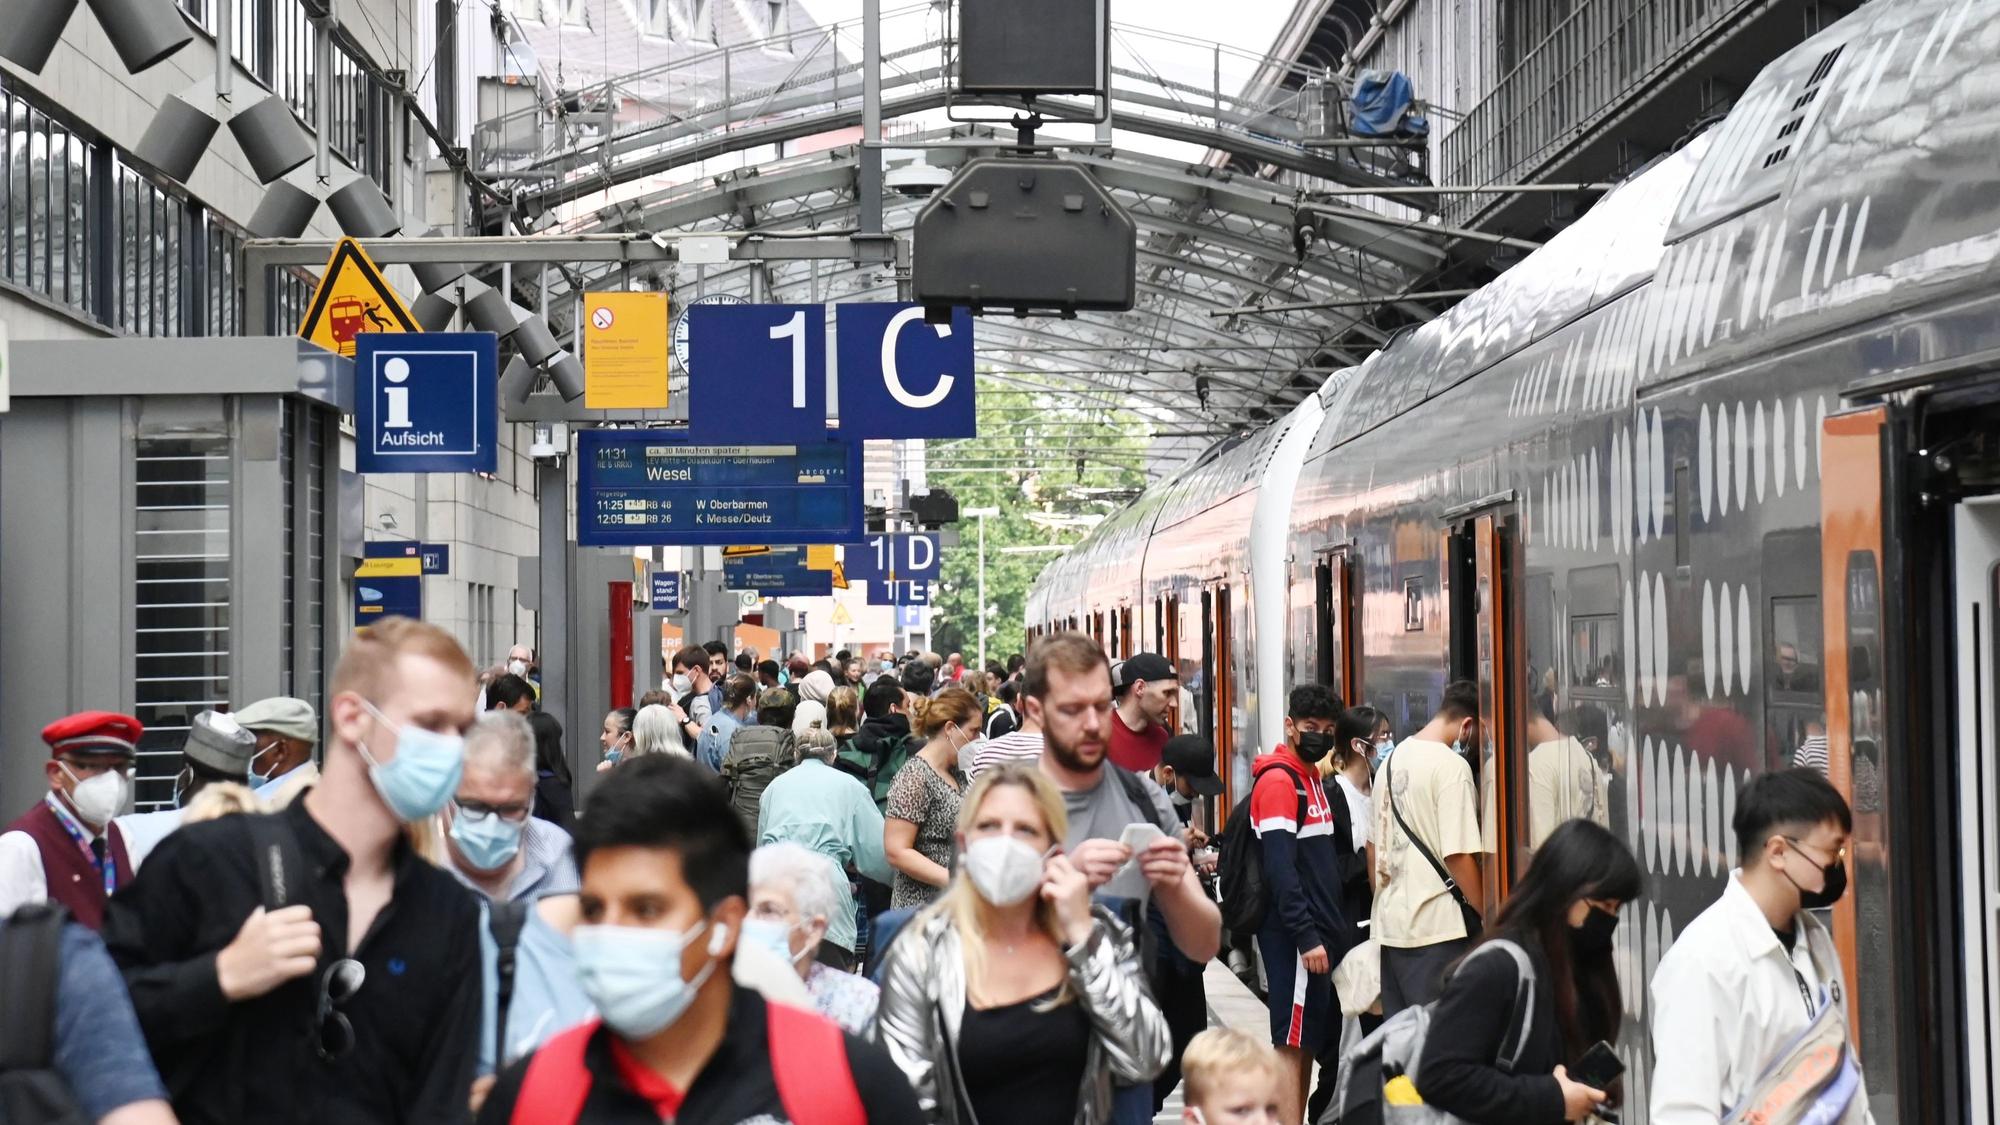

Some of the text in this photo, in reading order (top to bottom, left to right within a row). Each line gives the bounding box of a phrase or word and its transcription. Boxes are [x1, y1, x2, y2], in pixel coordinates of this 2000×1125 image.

[769, 306, 954, 408] 1 C
[381, 430, 444, 446] Aufsicht
[598, 448, 626, 459] 11:31
[646, 467, 692, 481] Wesel
[597, 500, 624, 510] 11:25
[646, 500, 658, 509] RB
[696, 500, 706, 509] W
[710, 500, 768, 510] Oberbarmen
[597, 514, 624, 524] 12:05
[646, 514, 658, 523] RB
[661, 514, 672, 523] 26
[696, 514, 703, 524] K
[707, 514, 772, 524] Messe/Deutz
[870, 535, 934, 570] 1 D
